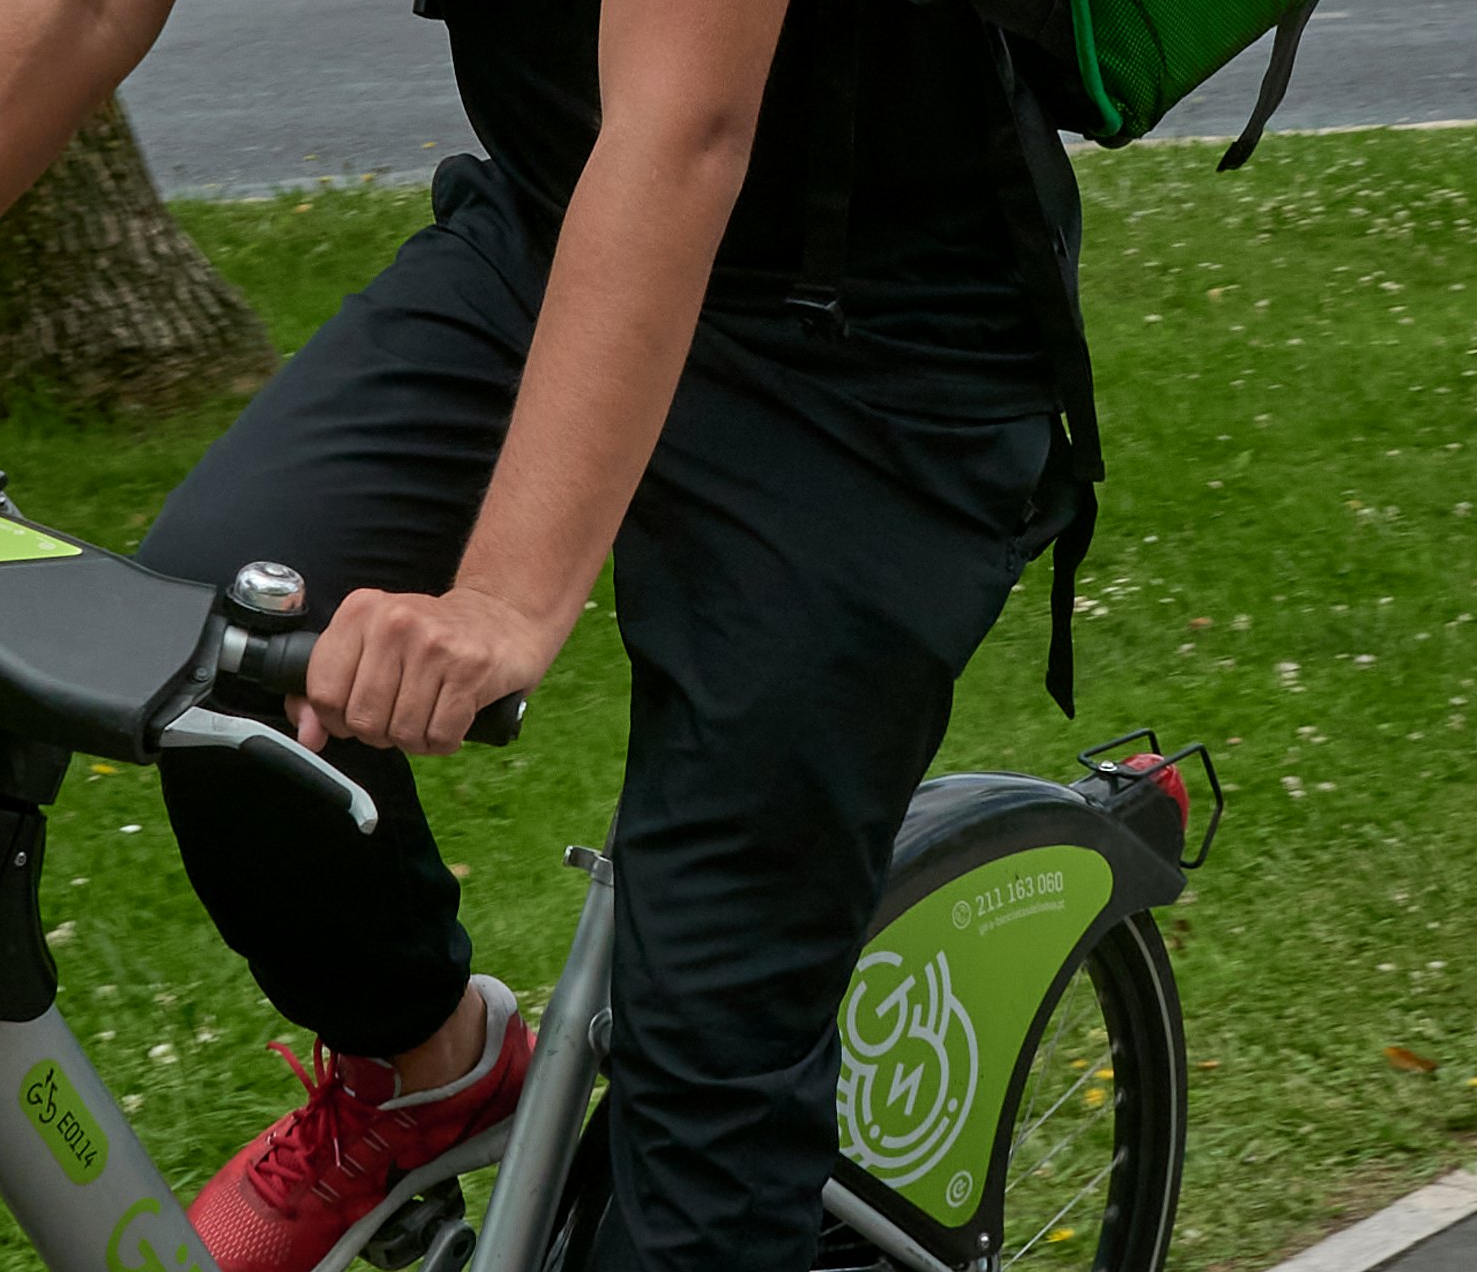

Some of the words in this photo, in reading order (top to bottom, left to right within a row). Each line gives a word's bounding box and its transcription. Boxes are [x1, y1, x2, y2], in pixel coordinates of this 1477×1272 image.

[975, 888, 1004, 917] 211
[1006, 876, 1035, 904] 163
[1037, 871, 1064, 895] 060
[56, 1110, 98, 1169] E0114
